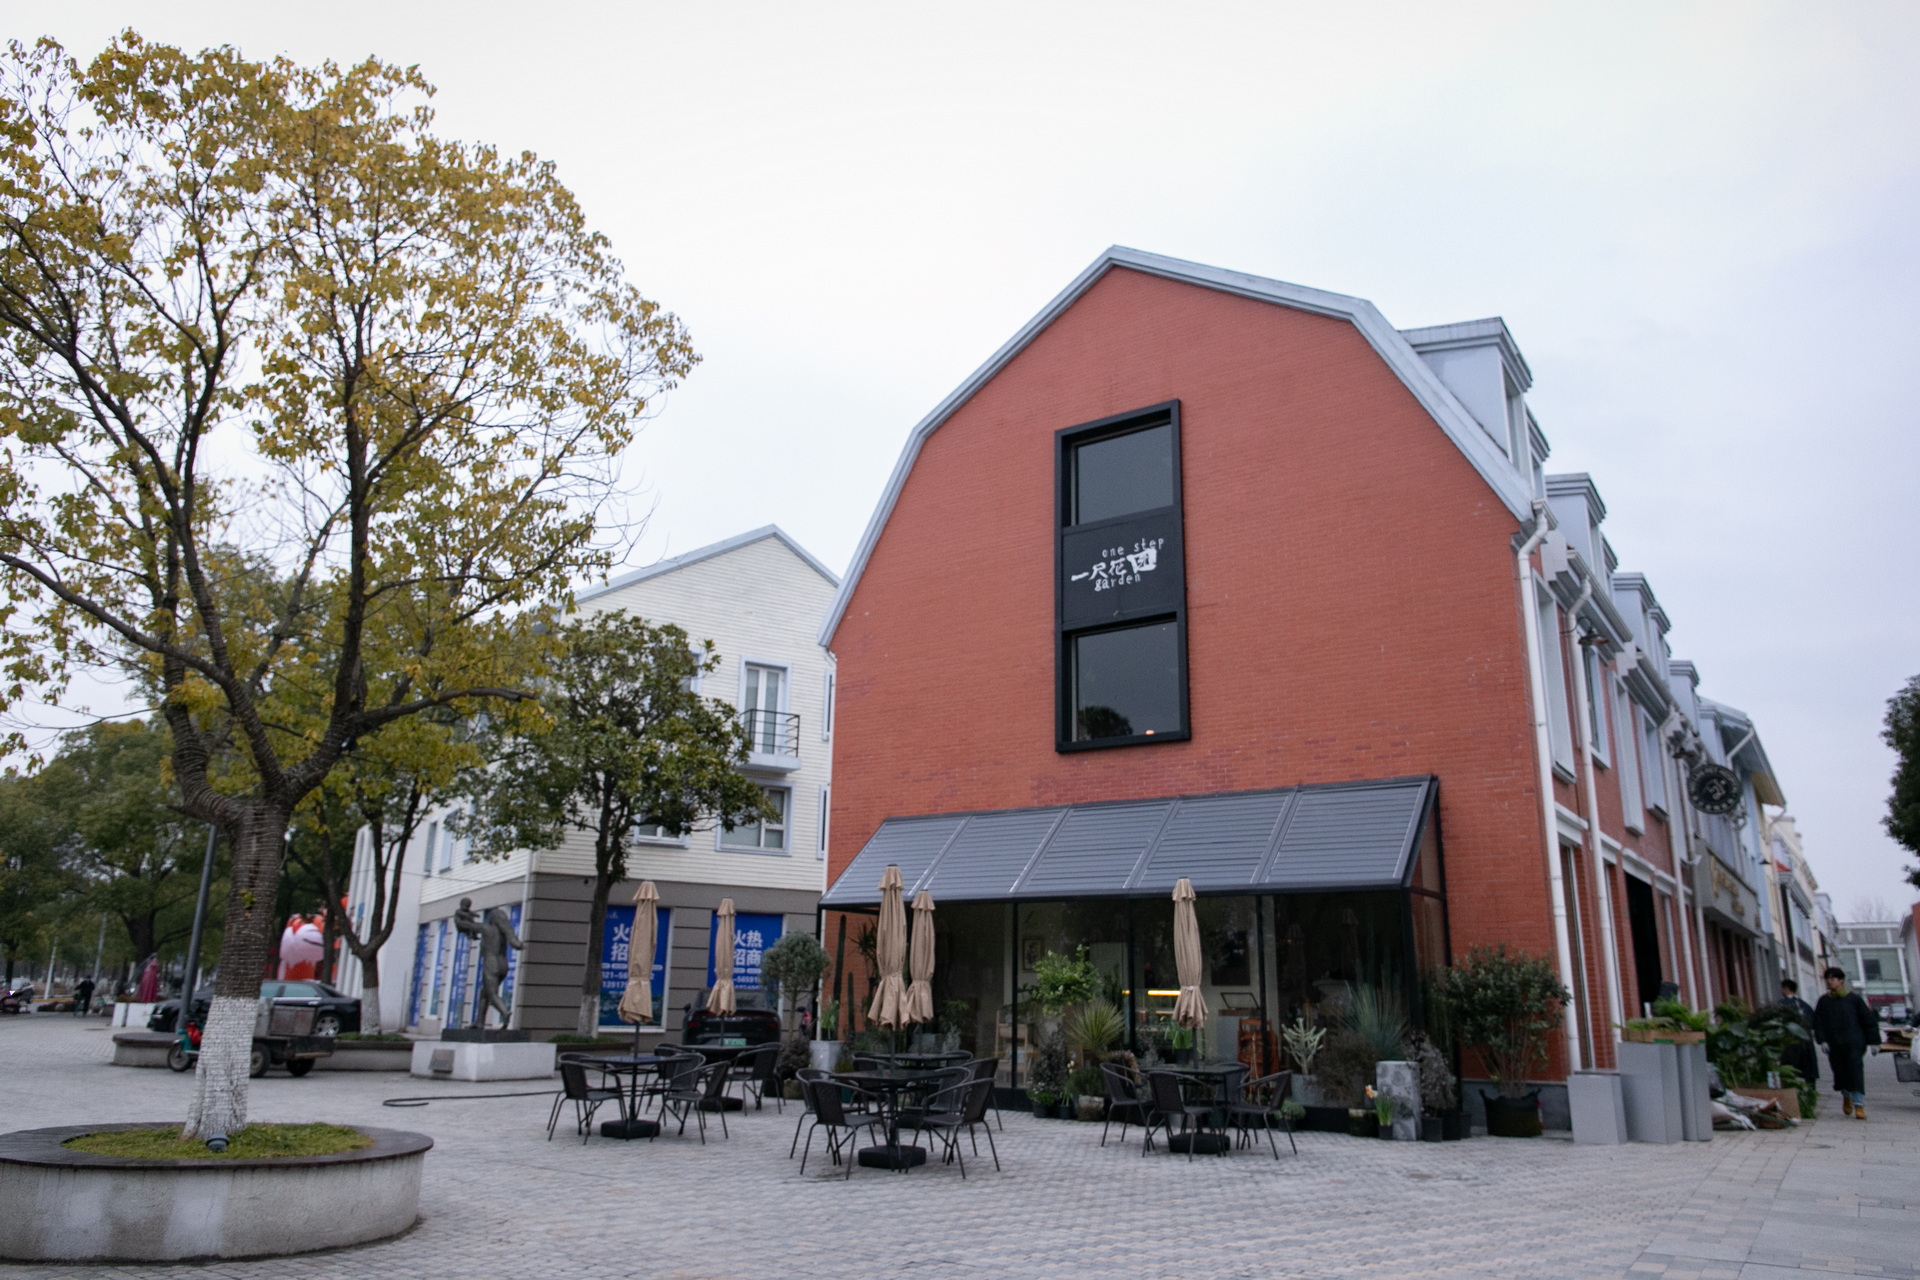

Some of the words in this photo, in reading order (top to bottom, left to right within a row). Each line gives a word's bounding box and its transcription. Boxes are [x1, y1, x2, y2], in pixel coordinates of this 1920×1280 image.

[1102, 546, 1125, 558] one
[1133, 538, 1165, 552] step
[1094, 573, 1142, 592] garden
[612, 923, 632, 942] 火
[734, 929, 763, 948] 火热
[610, 942, 629, 962] 招
